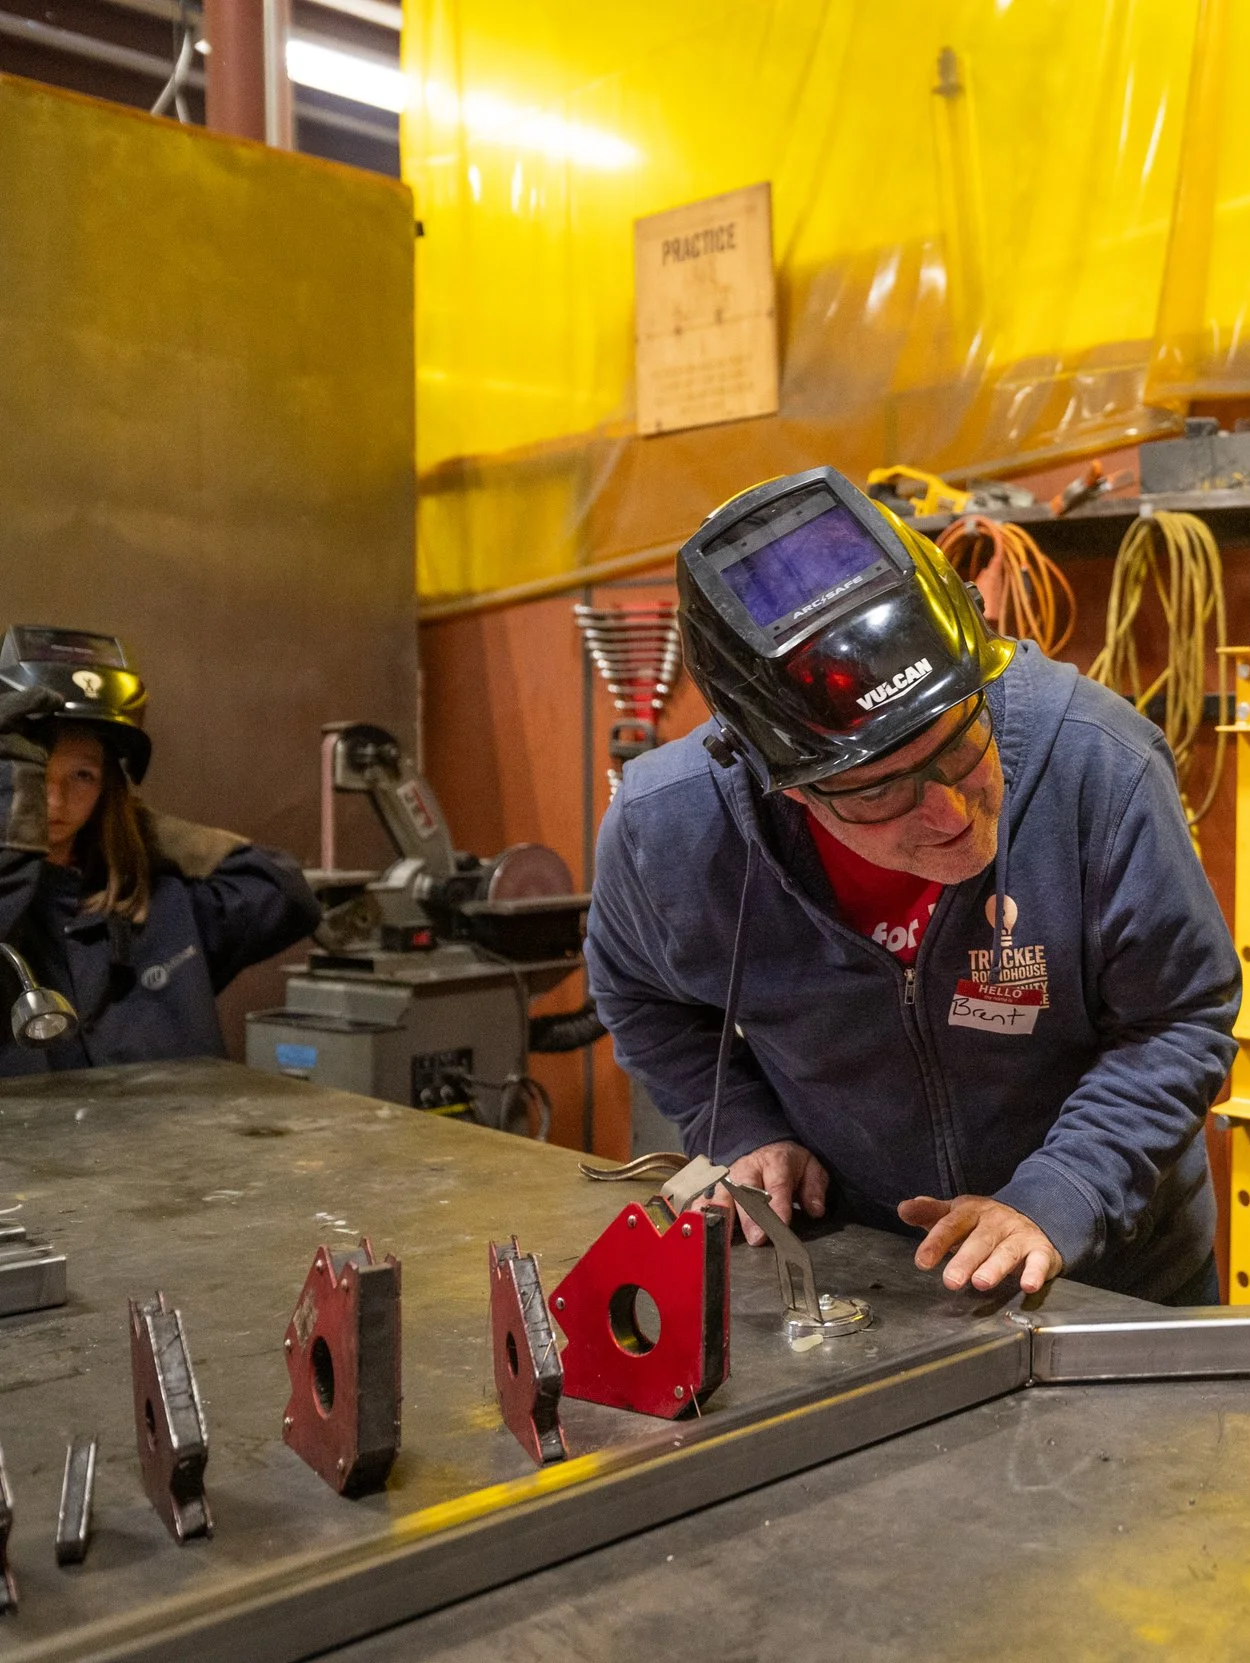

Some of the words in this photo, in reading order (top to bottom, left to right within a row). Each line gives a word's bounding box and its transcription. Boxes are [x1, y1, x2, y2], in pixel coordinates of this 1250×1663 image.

[661, 222, 736, 266] PRACTICE
[855, 657, 933, 711] VULCAN
[872, 918, 919, 952] for
[971, 964, 1047, 983] RODHOUSE
[978, 984, 1022, 998] HELLO
[952, 998, 1025, 1025] Brent
